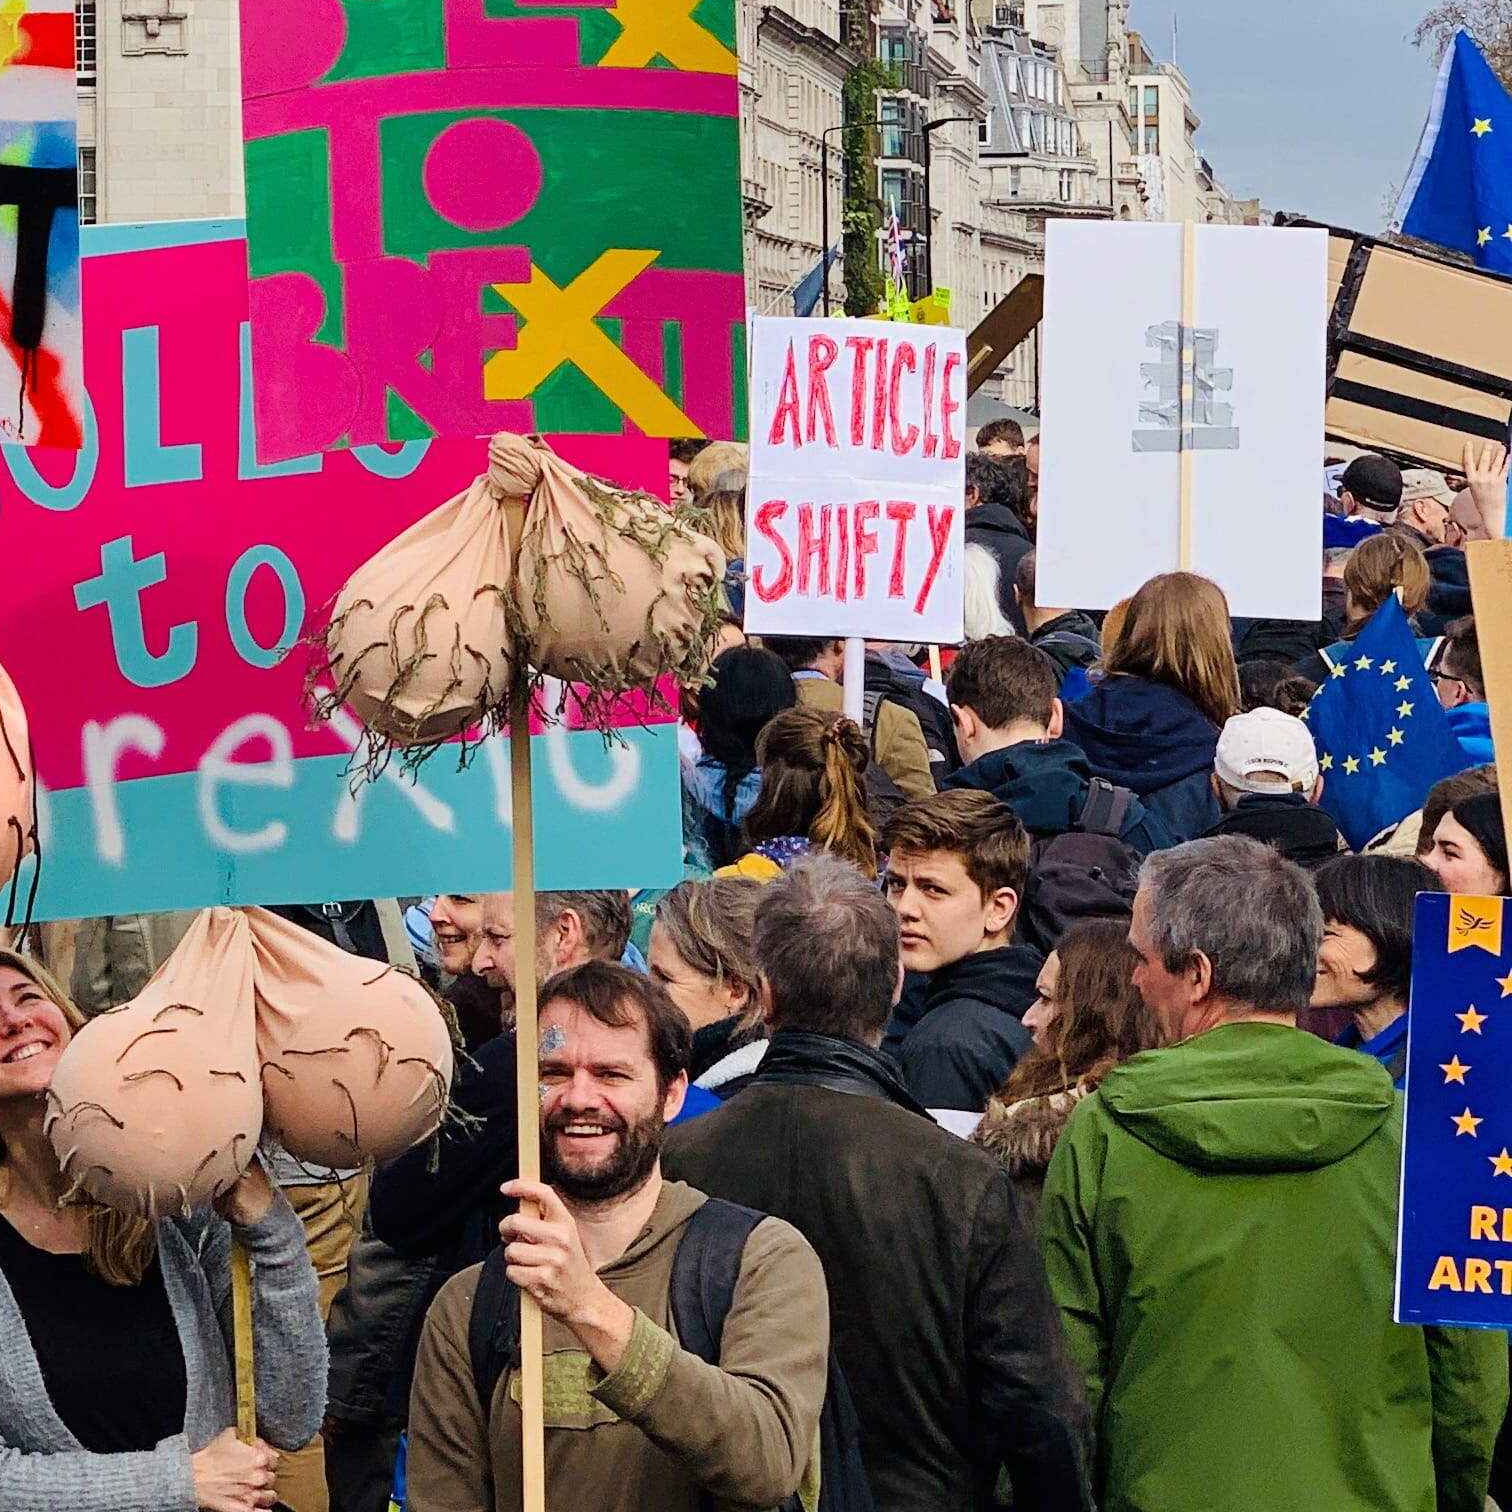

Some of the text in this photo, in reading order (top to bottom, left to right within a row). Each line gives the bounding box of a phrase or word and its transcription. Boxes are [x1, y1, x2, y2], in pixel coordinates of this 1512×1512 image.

[248, 245, 746, 457] BREXIT
[768, 333, 961, 459] ARTICLE
[73, 534, 305, 687] to
[752, 499, 956, 615] SHIFTY
